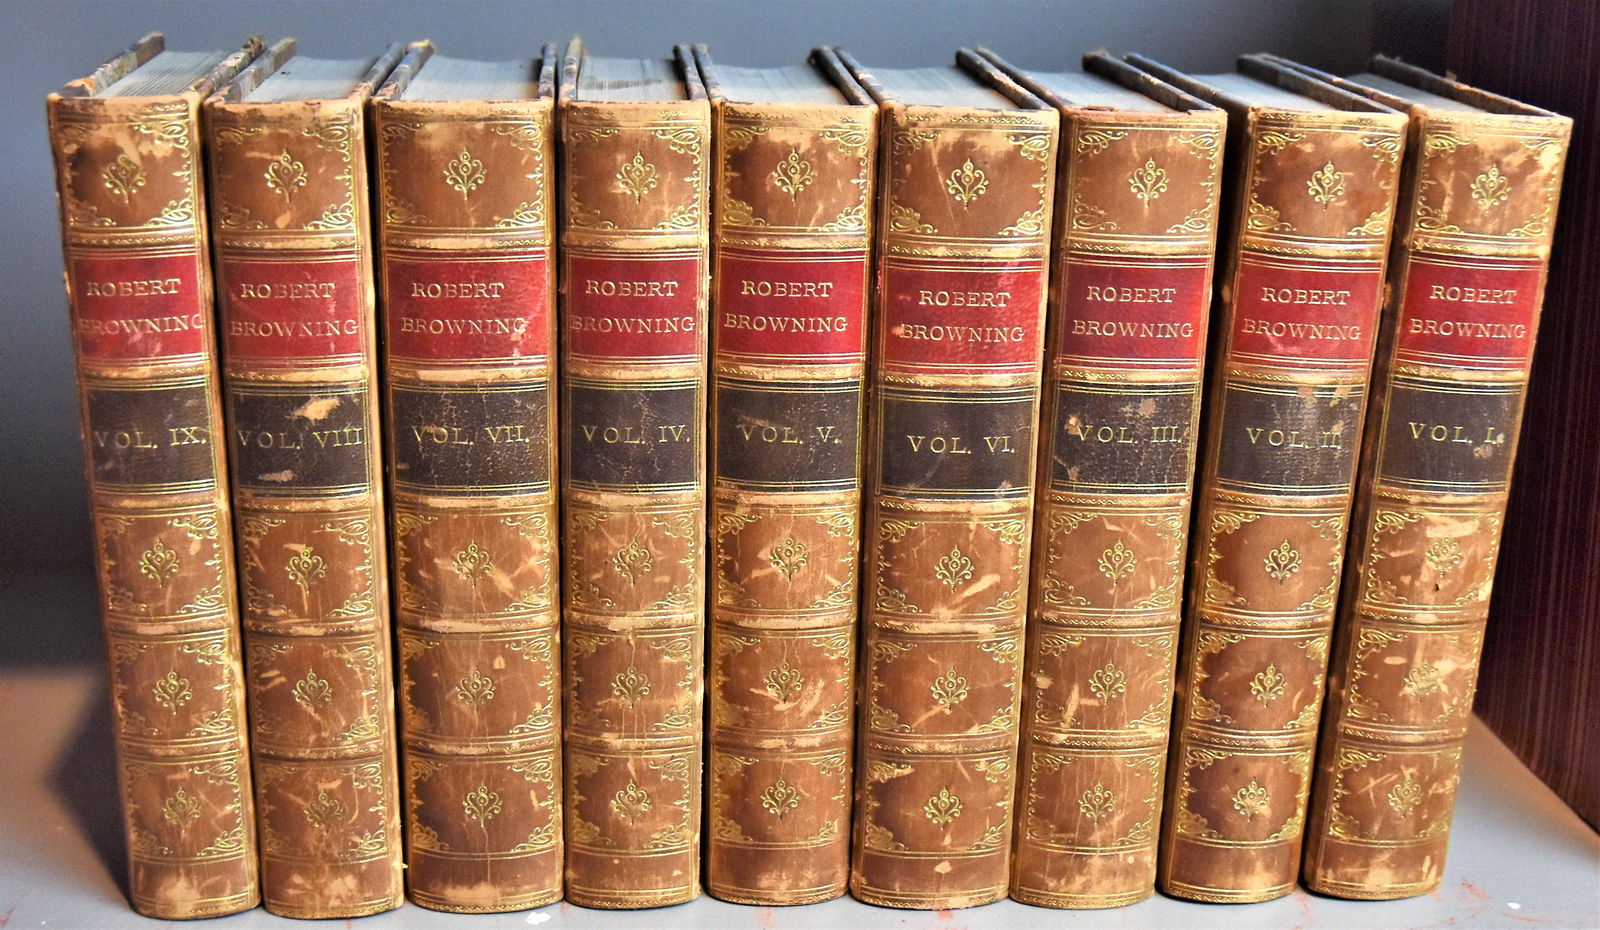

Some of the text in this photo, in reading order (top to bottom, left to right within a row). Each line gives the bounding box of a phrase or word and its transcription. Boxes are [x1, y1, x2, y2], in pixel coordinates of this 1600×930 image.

[86, 279, 181, 297] ROBERT
[241, 283, 336, 299] ROBERT
[411, 282, 505, 298] ROBERT
[585, 280, 679, 297] ROBERT
[741, 280, 833, 297] ROBERT
[1086, 286, 1176, 303] ROBERT
[1261, 287, 1351, 305] ROBERT
[1429, 285, 1518, 304] ROBERT
[919, 290, 1012, 307] ROBERT
[80, 314, 206, 336] BROWNING
[229, 320, 359, 337] BROWNING
[401, 317, 529, 334] BROWNING
[569, 316, 696, 332] BROWNING
[724, 313, 848, 332] BROWNING
[1072, 320, 1194, 338] BROWNING
[1241, 318, 1363, 341] BROWNING
[1408, 318, 1527, 339] BROWNING
[900, 324, 1025, 343] BROWNING
[94, 426, 206, 449] VOL. IX.
[238, 430, 300, 449] VOL.
[412, 425, 530, 445] VOL. VII.
[582, 425, 691, 445] VOL. IV.
[737, 424, 842, 445] VOL. V.
[1076, 425, 1183, 444] VOL. III.
[1246, 427, 1309, 448] VOL.
[1408, 421, 1473, 444] VOL.
[907, 435, 1016, 455] VOL. VI.
